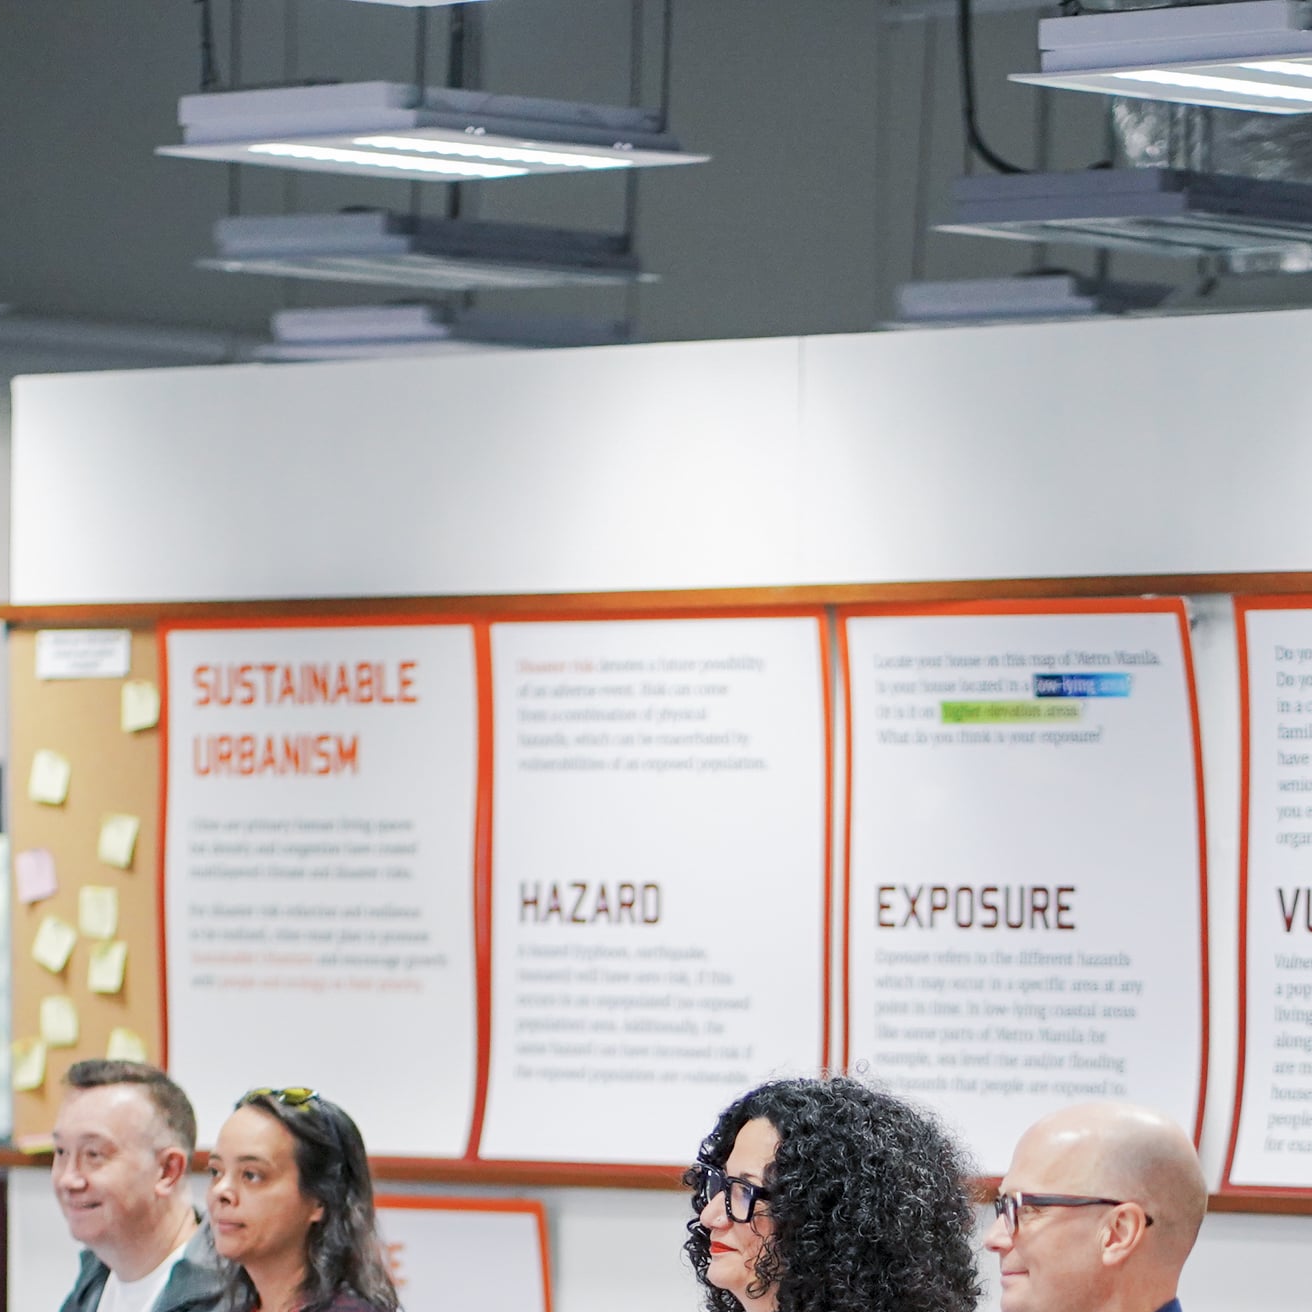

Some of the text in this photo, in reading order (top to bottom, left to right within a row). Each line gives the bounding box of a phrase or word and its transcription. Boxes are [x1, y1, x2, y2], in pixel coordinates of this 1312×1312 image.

[193, 660, 418, 706] SUSTAINABLE
[193, 734, 360, 777] URBANISM
[519, 881, 662, 925] HAZARD
[876, 885, 1077, 930] EXPOSURE
